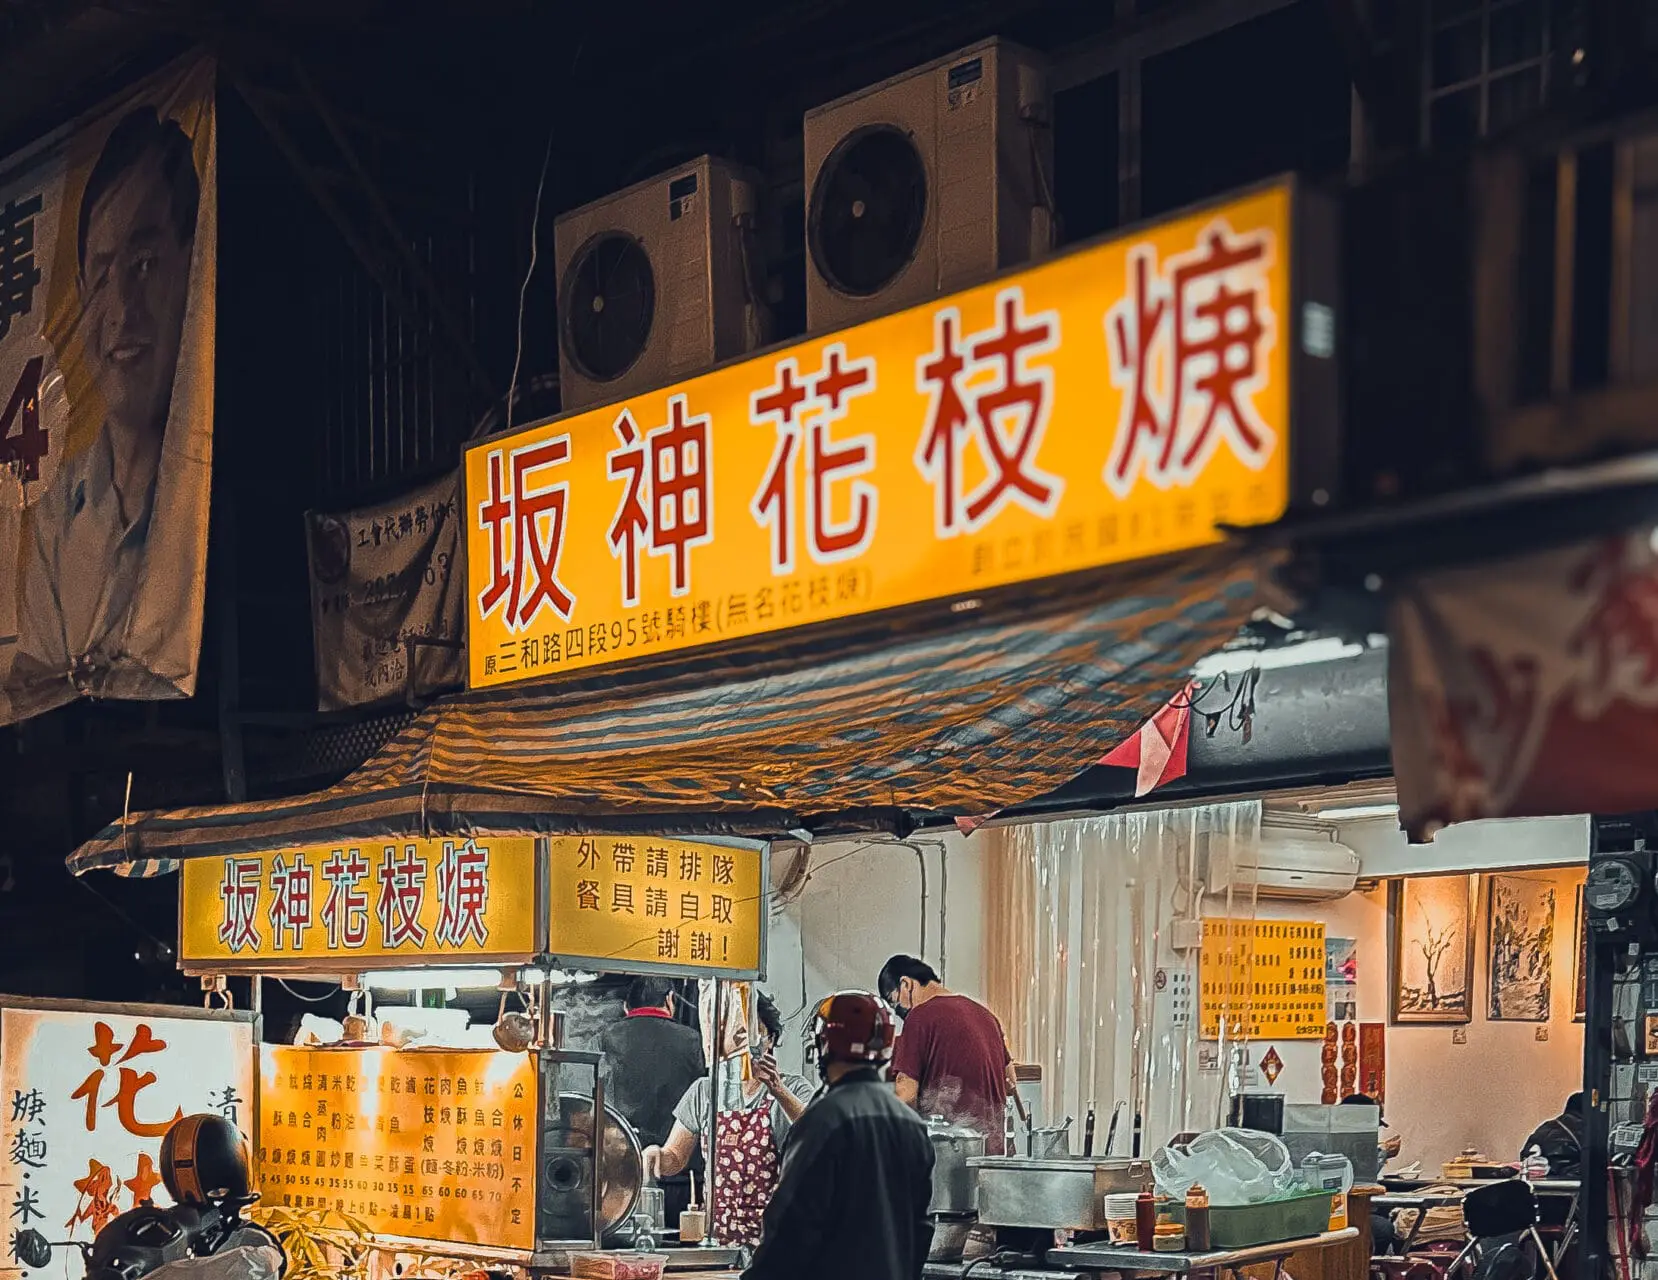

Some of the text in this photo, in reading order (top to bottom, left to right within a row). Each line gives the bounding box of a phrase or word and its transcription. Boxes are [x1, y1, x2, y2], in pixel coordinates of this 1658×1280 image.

[577, 838, 734, 885] 外帶請排隊
[577, 879, 733, 924] 餐具請自取
[511, 1083, 524, 1225] 公休日不定
[300, 1175, 310, 1185] 55
[314, 1177, 325, 1187] 45
[329, 1178, 340, 1188] 35
[343, 1179, 354, 1189] 35
[373, 1182, 384, 1191] 30
[388, 1183, 398, 1193] 15
[403, 1185, 414, 1195] 15
[422, 1186, 434, 1196] 65
[439, 1187, 450, 1197] 60
[455, 1188, 467, 1199] 60
[472, 1189, 483, 1200] 65
